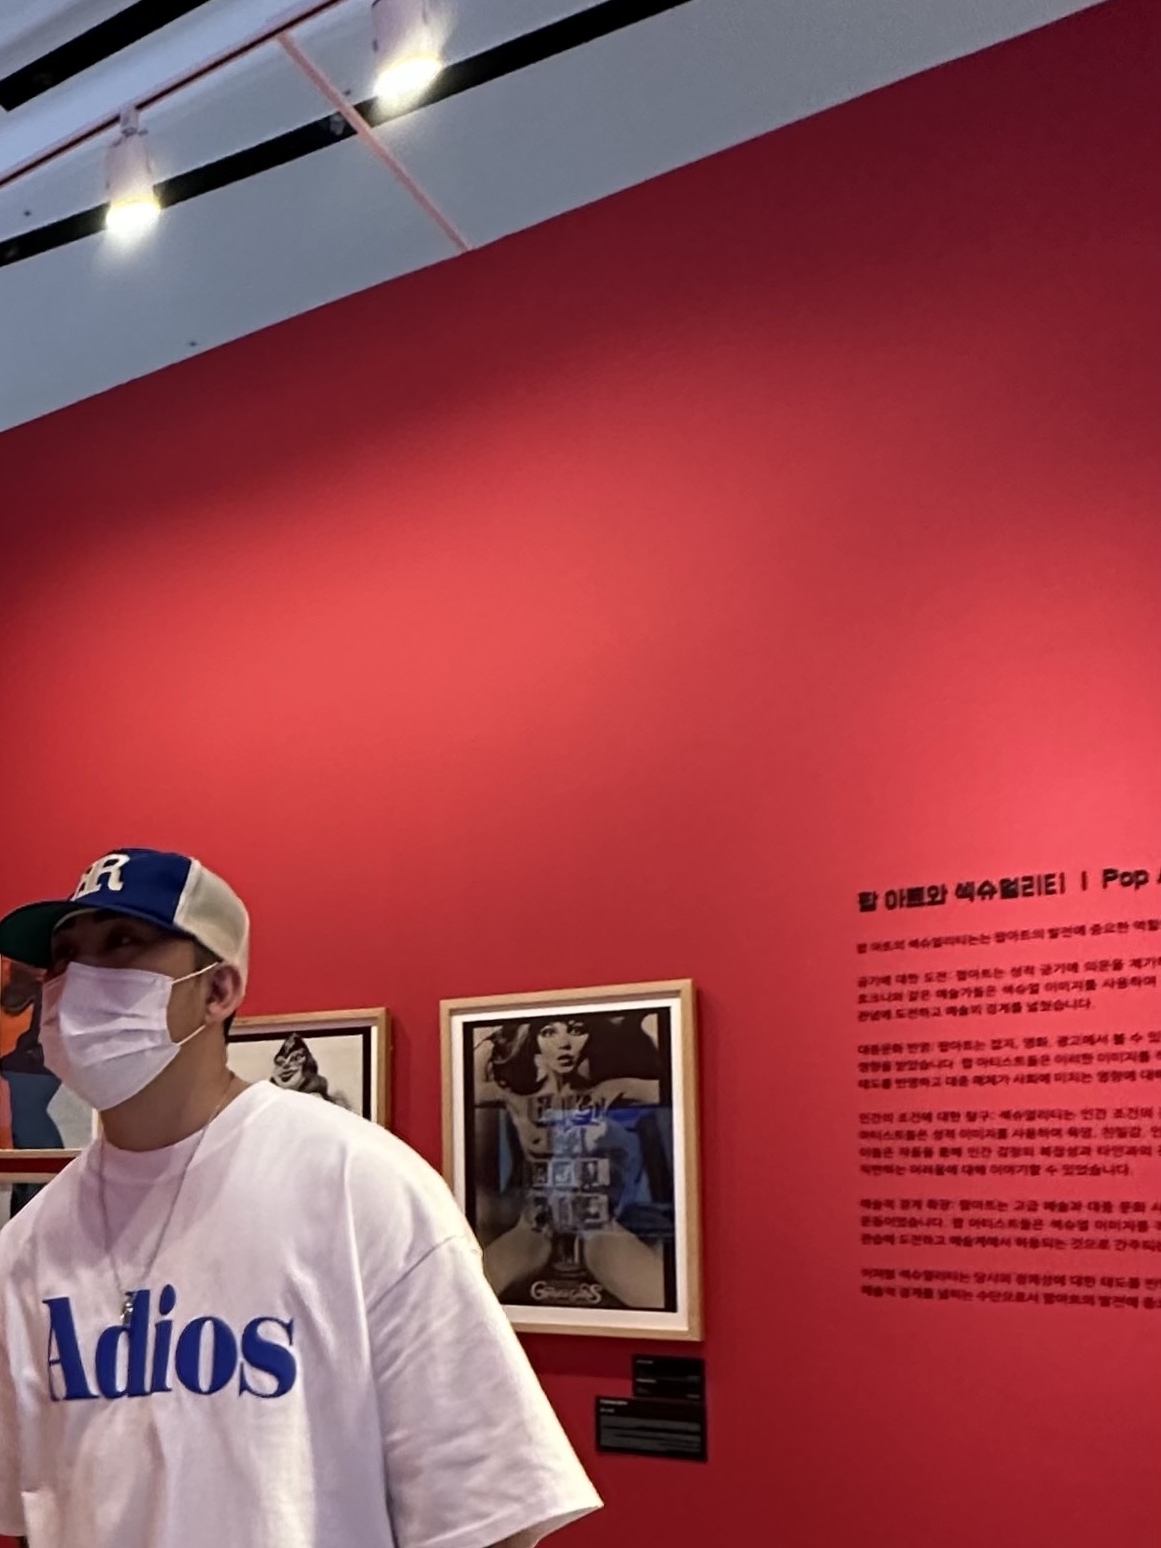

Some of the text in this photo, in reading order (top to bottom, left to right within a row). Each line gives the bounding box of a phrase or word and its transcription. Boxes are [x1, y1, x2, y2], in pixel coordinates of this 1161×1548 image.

[884, 884, 948, 911] 아트와
[954, 873, 1066, 903] 섹슈얼리티
[1101, 868, 1150, 890] Pop
[42, 1284, 297, 1402] Adios
